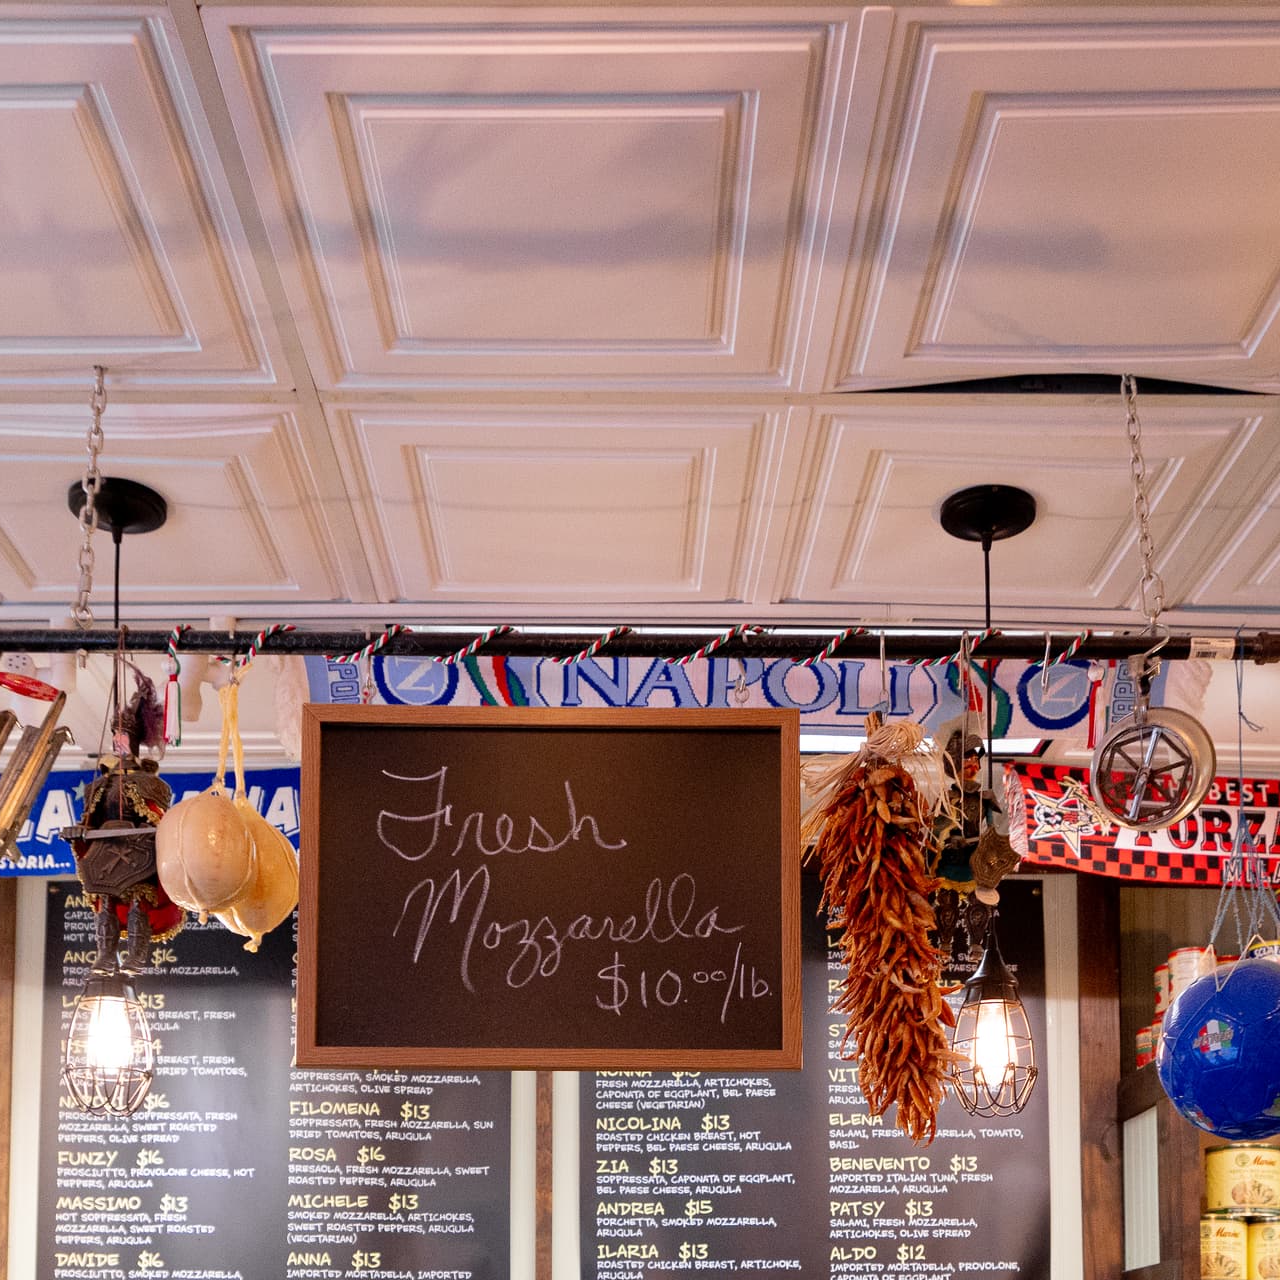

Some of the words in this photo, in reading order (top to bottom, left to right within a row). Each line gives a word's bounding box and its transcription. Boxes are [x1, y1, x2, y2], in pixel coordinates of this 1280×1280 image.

[562, 657, 914, 716] NAPOLI
[1210, 784, 1270, 803] BEST
[376, 765, 627, 863] Fresh
[392, 864, 747, 992] Mozzarella
[151, 948, 177, 968] $16
[289, 1101, 380, 1116] FILOMENA
[400, 1101, 430, 1121] $13
[829, 1113, 883, 1126] ELENA
[289, 1119, 361, 1129] SOPPRESSATA,
[365, 1120, 397, 1128] FRESH
[400, 1120, 471, 1130] MOZZARELLA,
[474, 1121, 494, 1129] SUN
[596, 1116, 681, 1131] NICOLINA
[701, 1113, 730, 1134] $13
[289, 1130, 321, 1139] DRIED
[325, 1131, 382, 1141] TOMATOES,
[385, 1132, 432, 1141] ARUGULA
[596, 1133, 643, 1141] ROASTED
[647, 1132, 691, 1141] CHICKEN
[694, 1132, 737, 1141] BREAST,
[739, 1131, 761, 1141] HOT
[57, 1151, 118, 1167] FUNZY
[136, 1149, 164, 1170] $16
[289, 1147, 336, 1162] ROSA
[357, 1146, 385, 1166] $16
[596, 1159, 629, 1173] ZIA
[648, 1156, 678, 1177] $13
[829, 1156, 930, 1171] BENEVENTO
[950, 1154, 978, 1175] $13
[56, 1196, 141, 1211] MASSIMO
[159, 1194, 188, 1216] $13
[288, 1194, 369, 1208] MICHELE
[388, 1193, 418, 1214] $13
[597, 1202, 664, 1216] ANDREA
[685, 1199, 713, 1220] $15
[830, 1201, 885, 1218] PATSY
[905, 1199, 933, 1219] $13
[830, 1219, 870, 1228] SALAMI,
[872, 1219, 905, 1227] FRESH
[908, 1218, 978, 1228] MOZZARELLA,
[55, 1253, 119, 1268] DAVIDE
[137, 1251, 164, 1272] $16
[287, 1252, 331, 1266] ANNA
[351, 1250, 381, 1271] $13
[597, 1244, 659, 1259] ILARIA
[679, 1242, 708, 1263] $13
[830, 1246, 877, 1261] ALDO
[897, 1243, 926, 1264] $12
[54, 1269, 126, 1280] PROSCIUTTO,
[128, 1270, 168, 1279] SMOKED
[172, 1270, 243, 1280] MOZZARELLA,
[287, 1269, 342, 1279] IMPORTED
[345, 1270, 414, 1280] MORTADELLA,
[417, 1271, 472, 1280] IMPORTED
[830, 1263, 884, 1273] IMPORTED
[887, 1263, 956, 1273] MORTADELLA,
[959, 1261, 1021, 1272] PROVOLONE,
